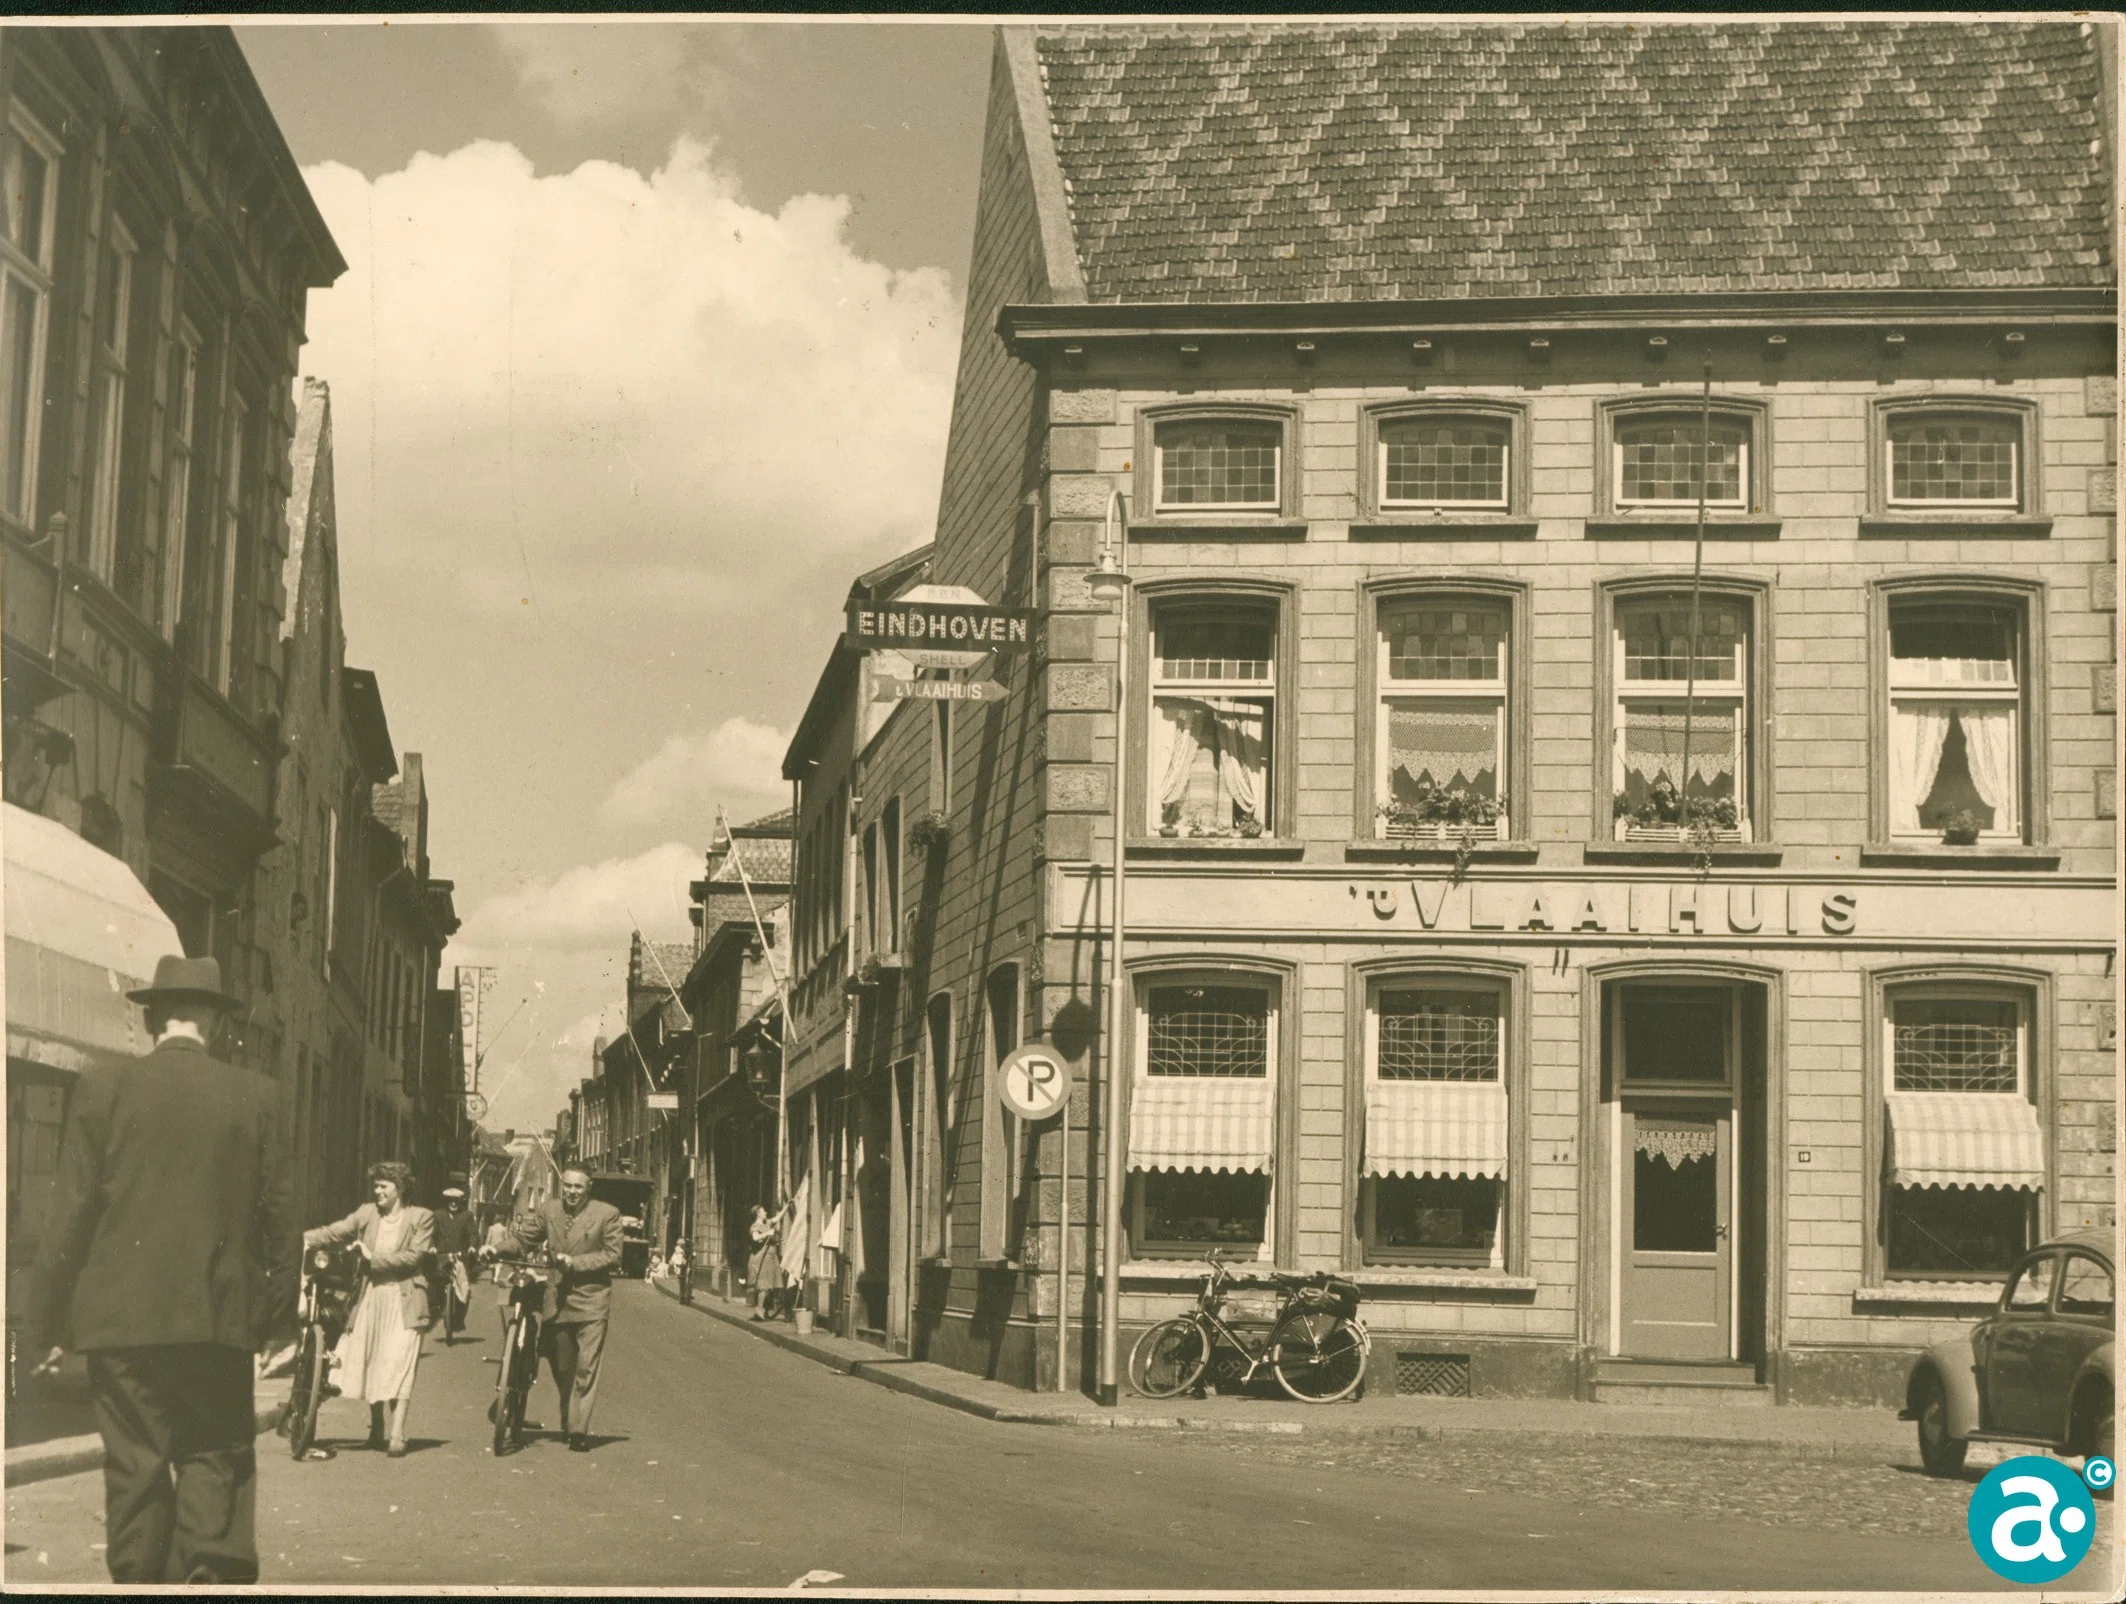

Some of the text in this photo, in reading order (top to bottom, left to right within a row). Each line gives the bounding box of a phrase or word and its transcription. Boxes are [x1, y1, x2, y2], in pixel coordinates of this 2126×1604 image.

[859, 611, 1027, 642] EINDHOVEN
[919, 653, 966, 665] SHELL
[906, 682, 982, 699] VLAAIHUIS
[1411, 880, 1858, 935] VLAAIHUIS
[460, 970, 476, 1087] APOO
[1028, 1060, 1056, 1102] P
